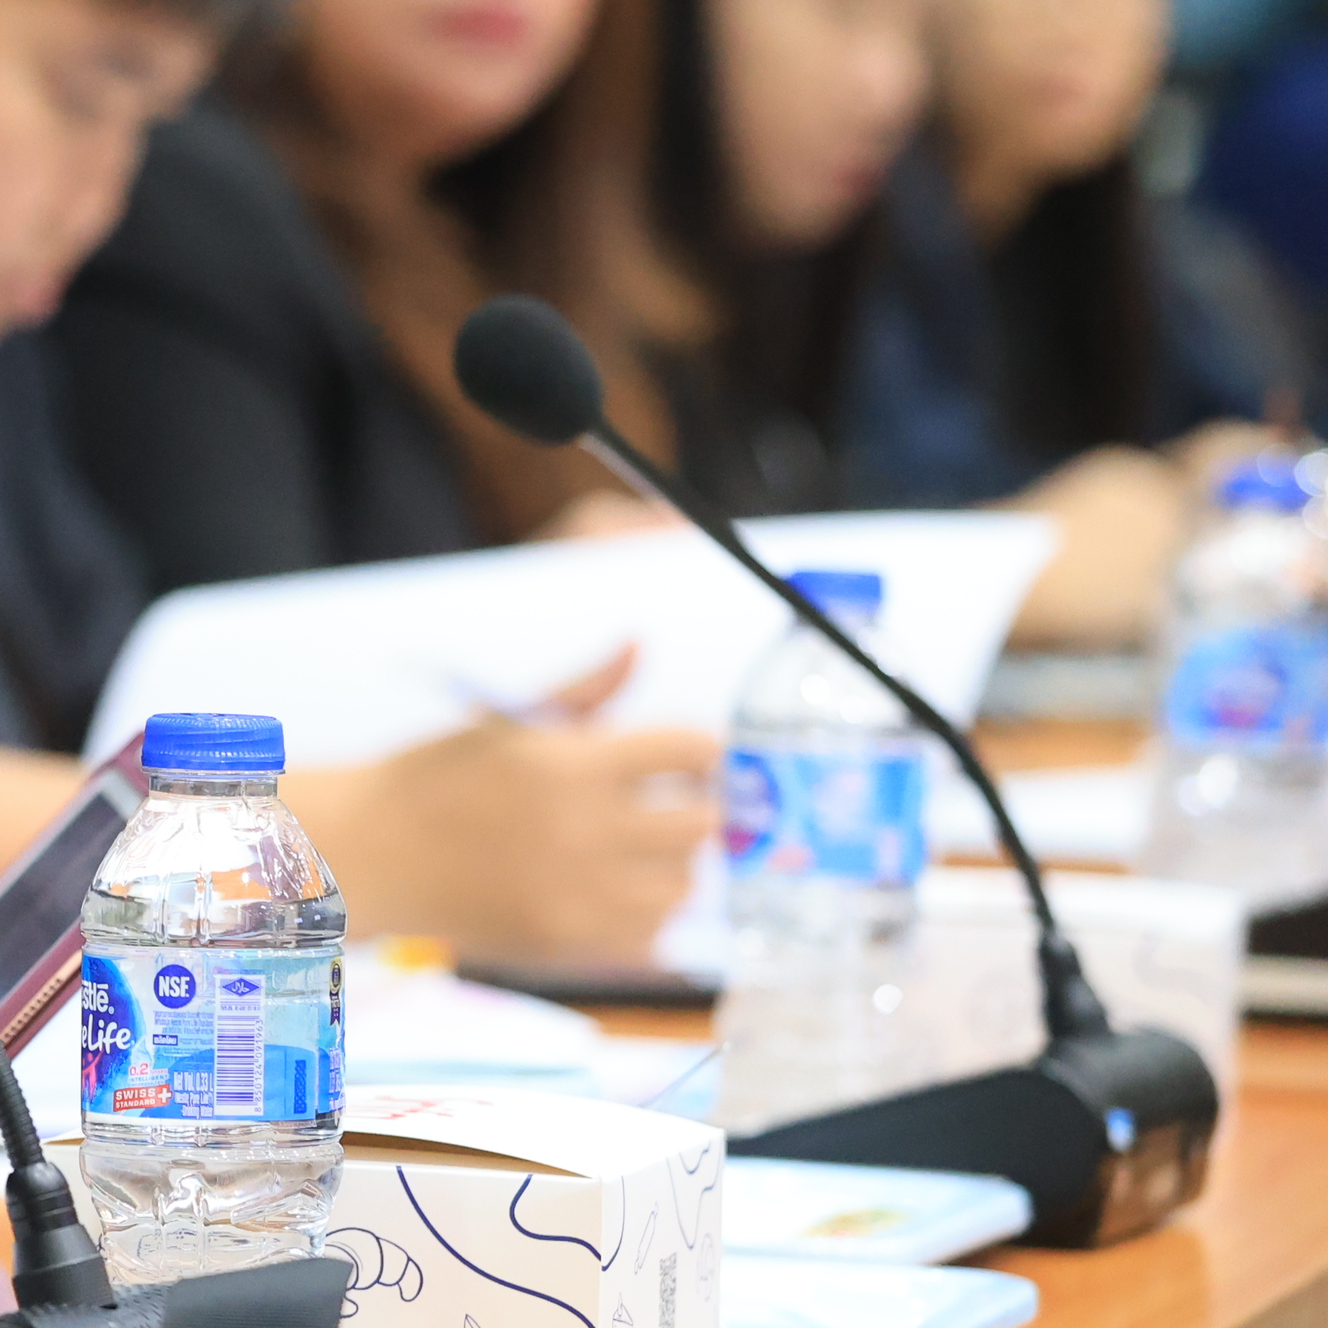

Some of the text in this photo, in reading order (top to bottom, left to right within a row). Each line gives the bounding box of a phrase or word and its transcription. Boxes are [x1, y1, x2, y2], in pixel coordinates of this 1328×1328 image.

[82, 980, 109, 1013] stlé
[130, 1062, 149, 1076] 0.2
[115, 1087, 156, 1101] SWISS
[115, 1098, 156, 1109] STANDARD
